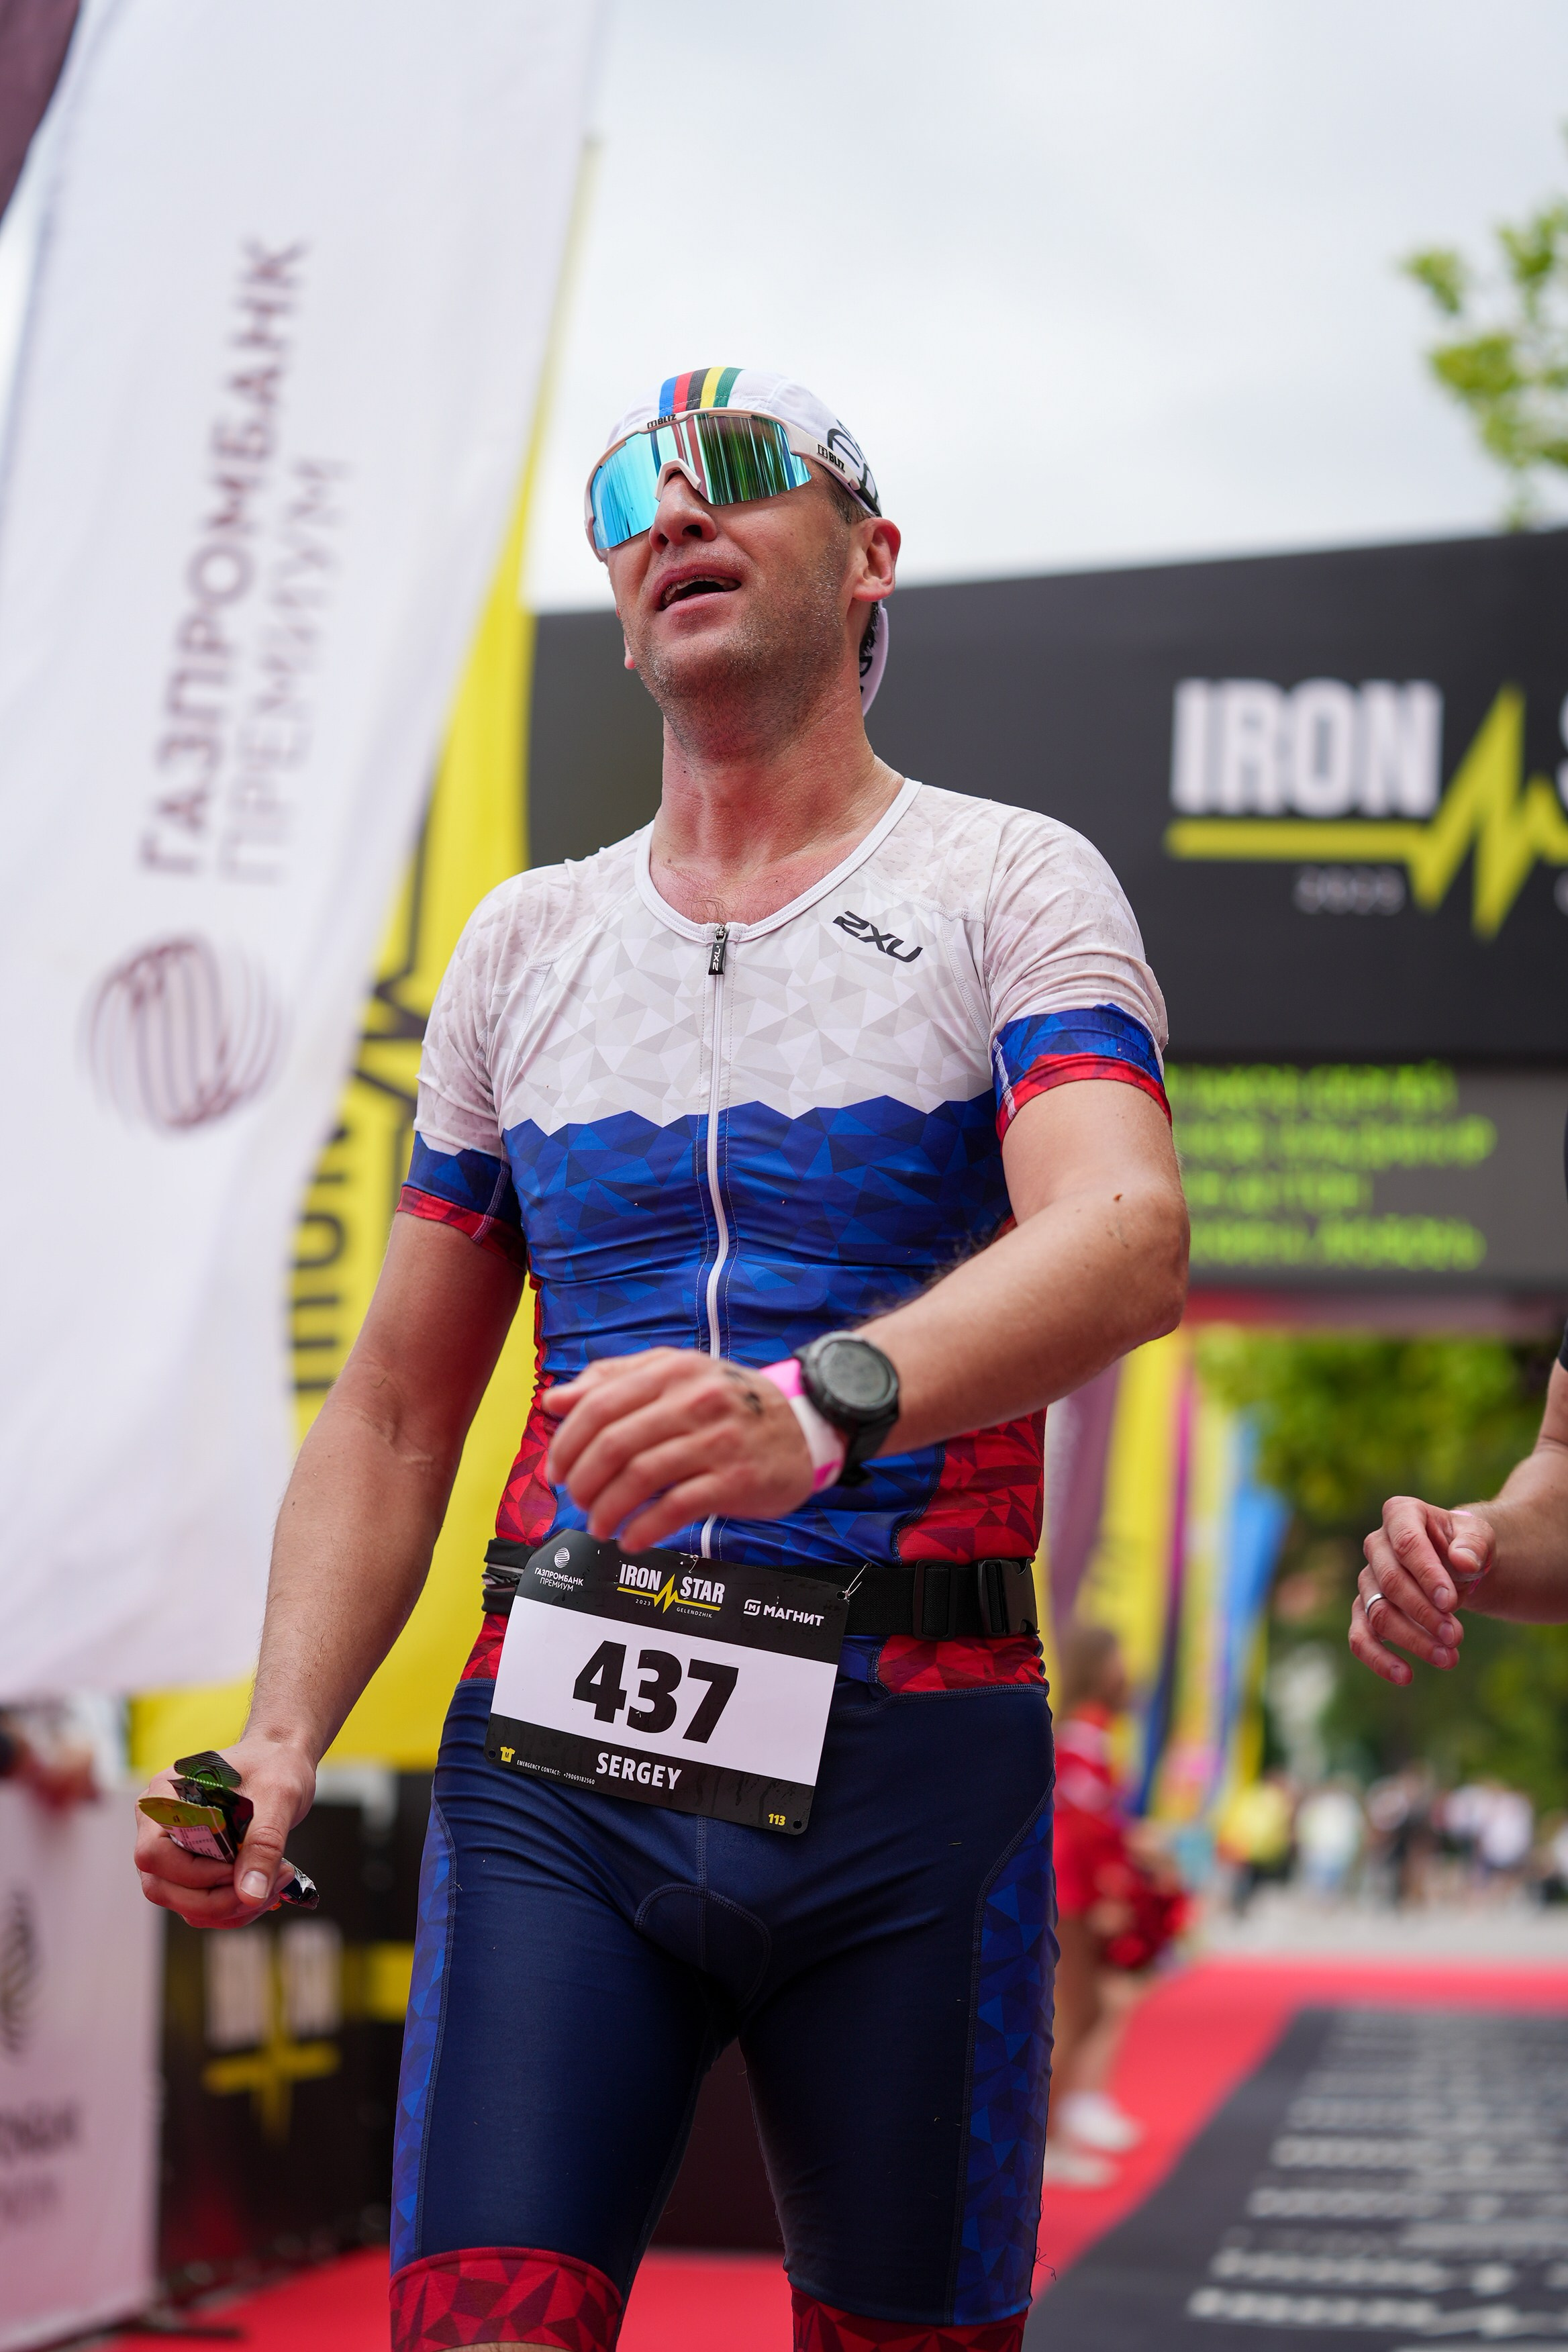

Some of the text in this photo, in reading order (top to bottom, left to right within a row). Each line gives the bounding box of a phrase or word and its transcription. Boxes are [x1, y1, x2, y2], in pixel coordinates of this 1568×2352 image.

[657, 414, 677, 425] BLIZ
[139, 238, 309, 873] ГАЗПРОМБАНК
[217, 456, 350, 884] ПРЕМИУМ
[1171, 677, 1444, 816] IRON
[832, 910, 924, 963] 2XU
[712, 945, 720, 971] 2XU
[534, 1567, 584, 1586] ГАЗПРОМБАНК
[540, 1577, 574, 1591] ПРЕМИУМ
[619, 1563, 726, 1604] IRON STAR
[635, 1598, 713, 1618] 2023 GELENDZHIK
[763, 1605, 824, 1626] МАГНИТ
[572, 1640, 740, 1744] 437
[517, 1759, 541, 1771] EMERGENCY
[541, 1766, 561, 1776] CONTACT:
[595, 1752, 682, 1790] SERGEY
[767, 1813, 786, 1826] 113
